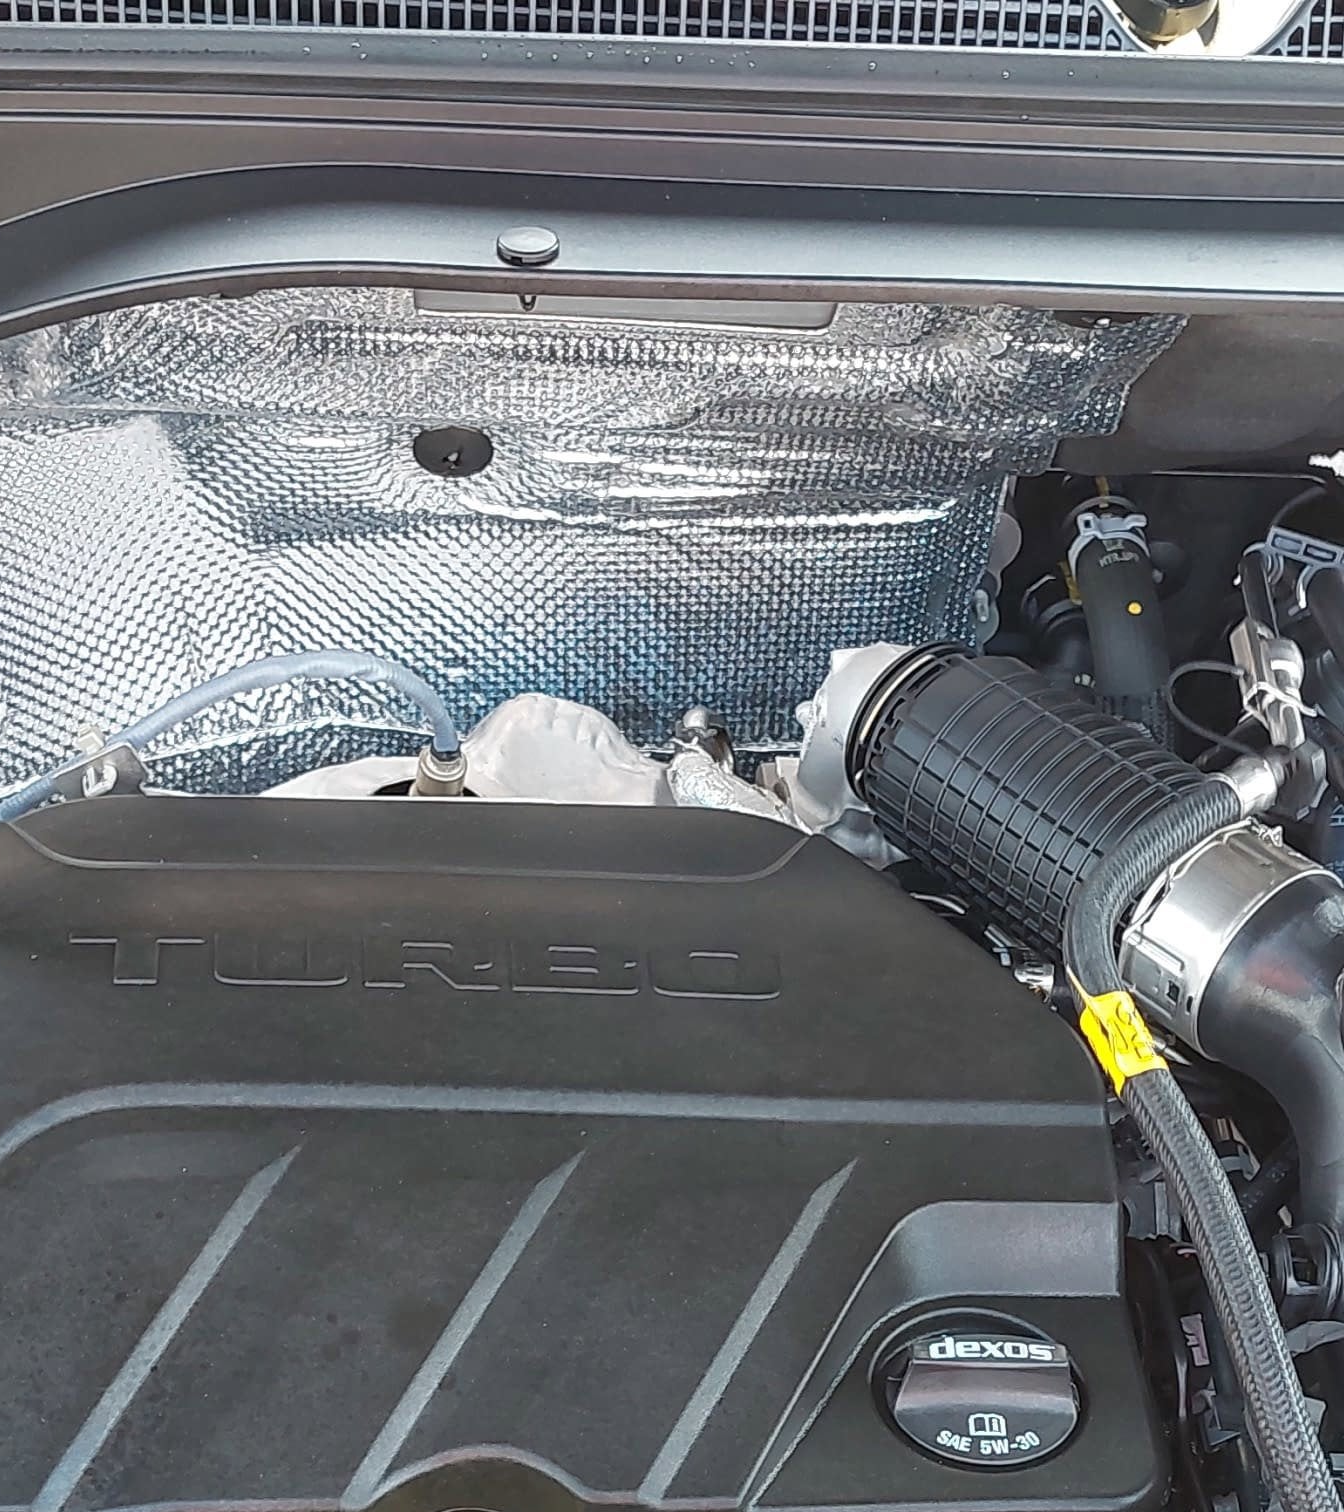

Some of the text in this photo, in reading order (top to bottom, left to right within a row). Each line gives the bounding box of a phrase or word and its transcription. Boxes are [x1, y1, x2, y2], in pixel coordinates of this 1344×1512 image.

[69, 937, 781, 1000] TURBO
[928, 1335, 1056, 1361] dexos
[936, 1429, 1040, 1456] SAE 5W-30
